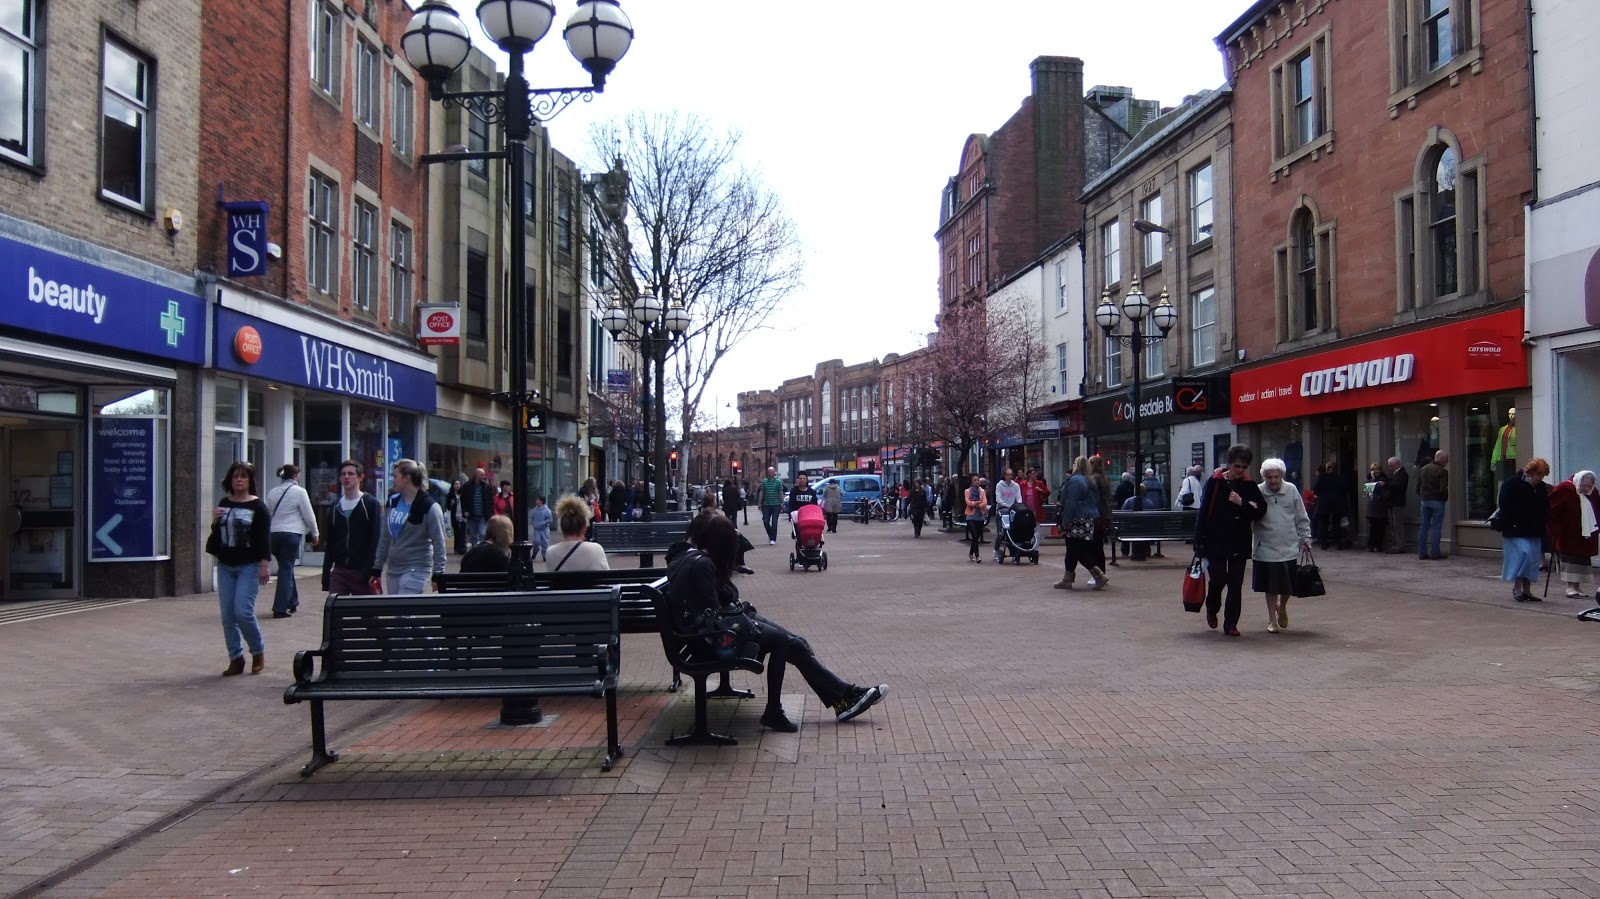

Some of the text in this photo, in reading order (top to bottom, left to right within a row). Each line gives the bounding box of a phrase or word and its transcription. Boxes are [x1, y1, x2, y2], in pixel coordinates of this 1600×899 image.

[232, 214, 260, 229] WH
[232, 229, 260, 272] S
[28, 266, 107, 324] beauty
[242, 343, 260, 355] OFFICE
[245, 333, 258, 344] POST
[300, 335, 395, 403] WHSmith
[1300, 353, 1413, 397] COTSWOLD
[1239, 384, 1292, 403] outdoor action travel
[1124, 398, 1164, 421] Clyesdale
[99, 428, 146, 437] welcome
